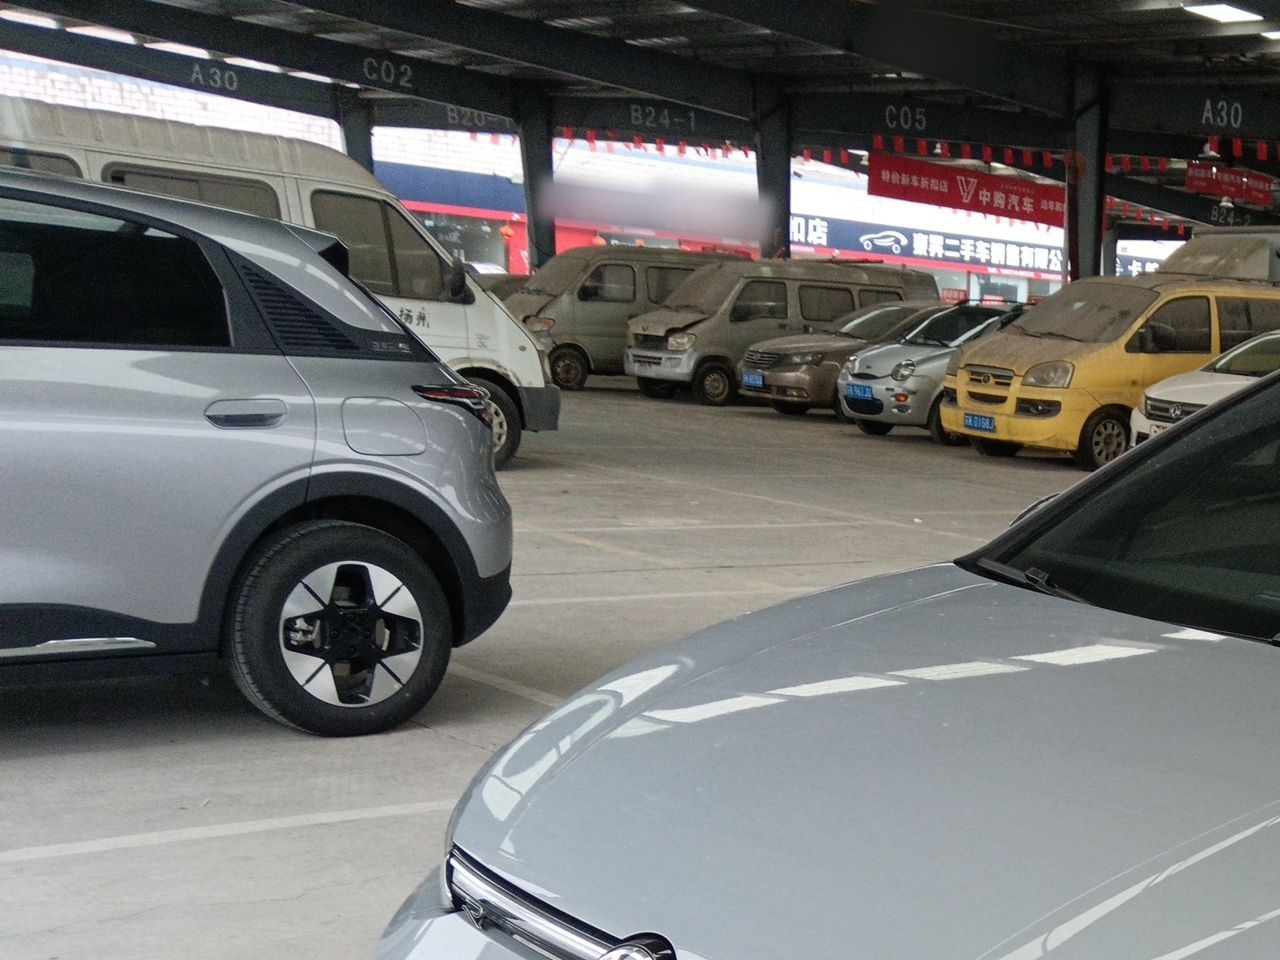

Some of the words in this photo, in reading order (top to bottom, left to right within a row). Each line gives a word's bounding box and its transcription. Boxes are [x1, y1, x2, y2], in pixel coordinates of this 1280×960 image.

[189, 65, 238, 91] A30
[362, 57, 414, 88] C02
[630, 104, 696, 131] B24-1
[885, 104, 927, 130] C05
[1201, 99, 1242, 129] A30
[978, 188, 1034, 214] 中购汽车
[1211, 205, 1252, 226] B24-2
